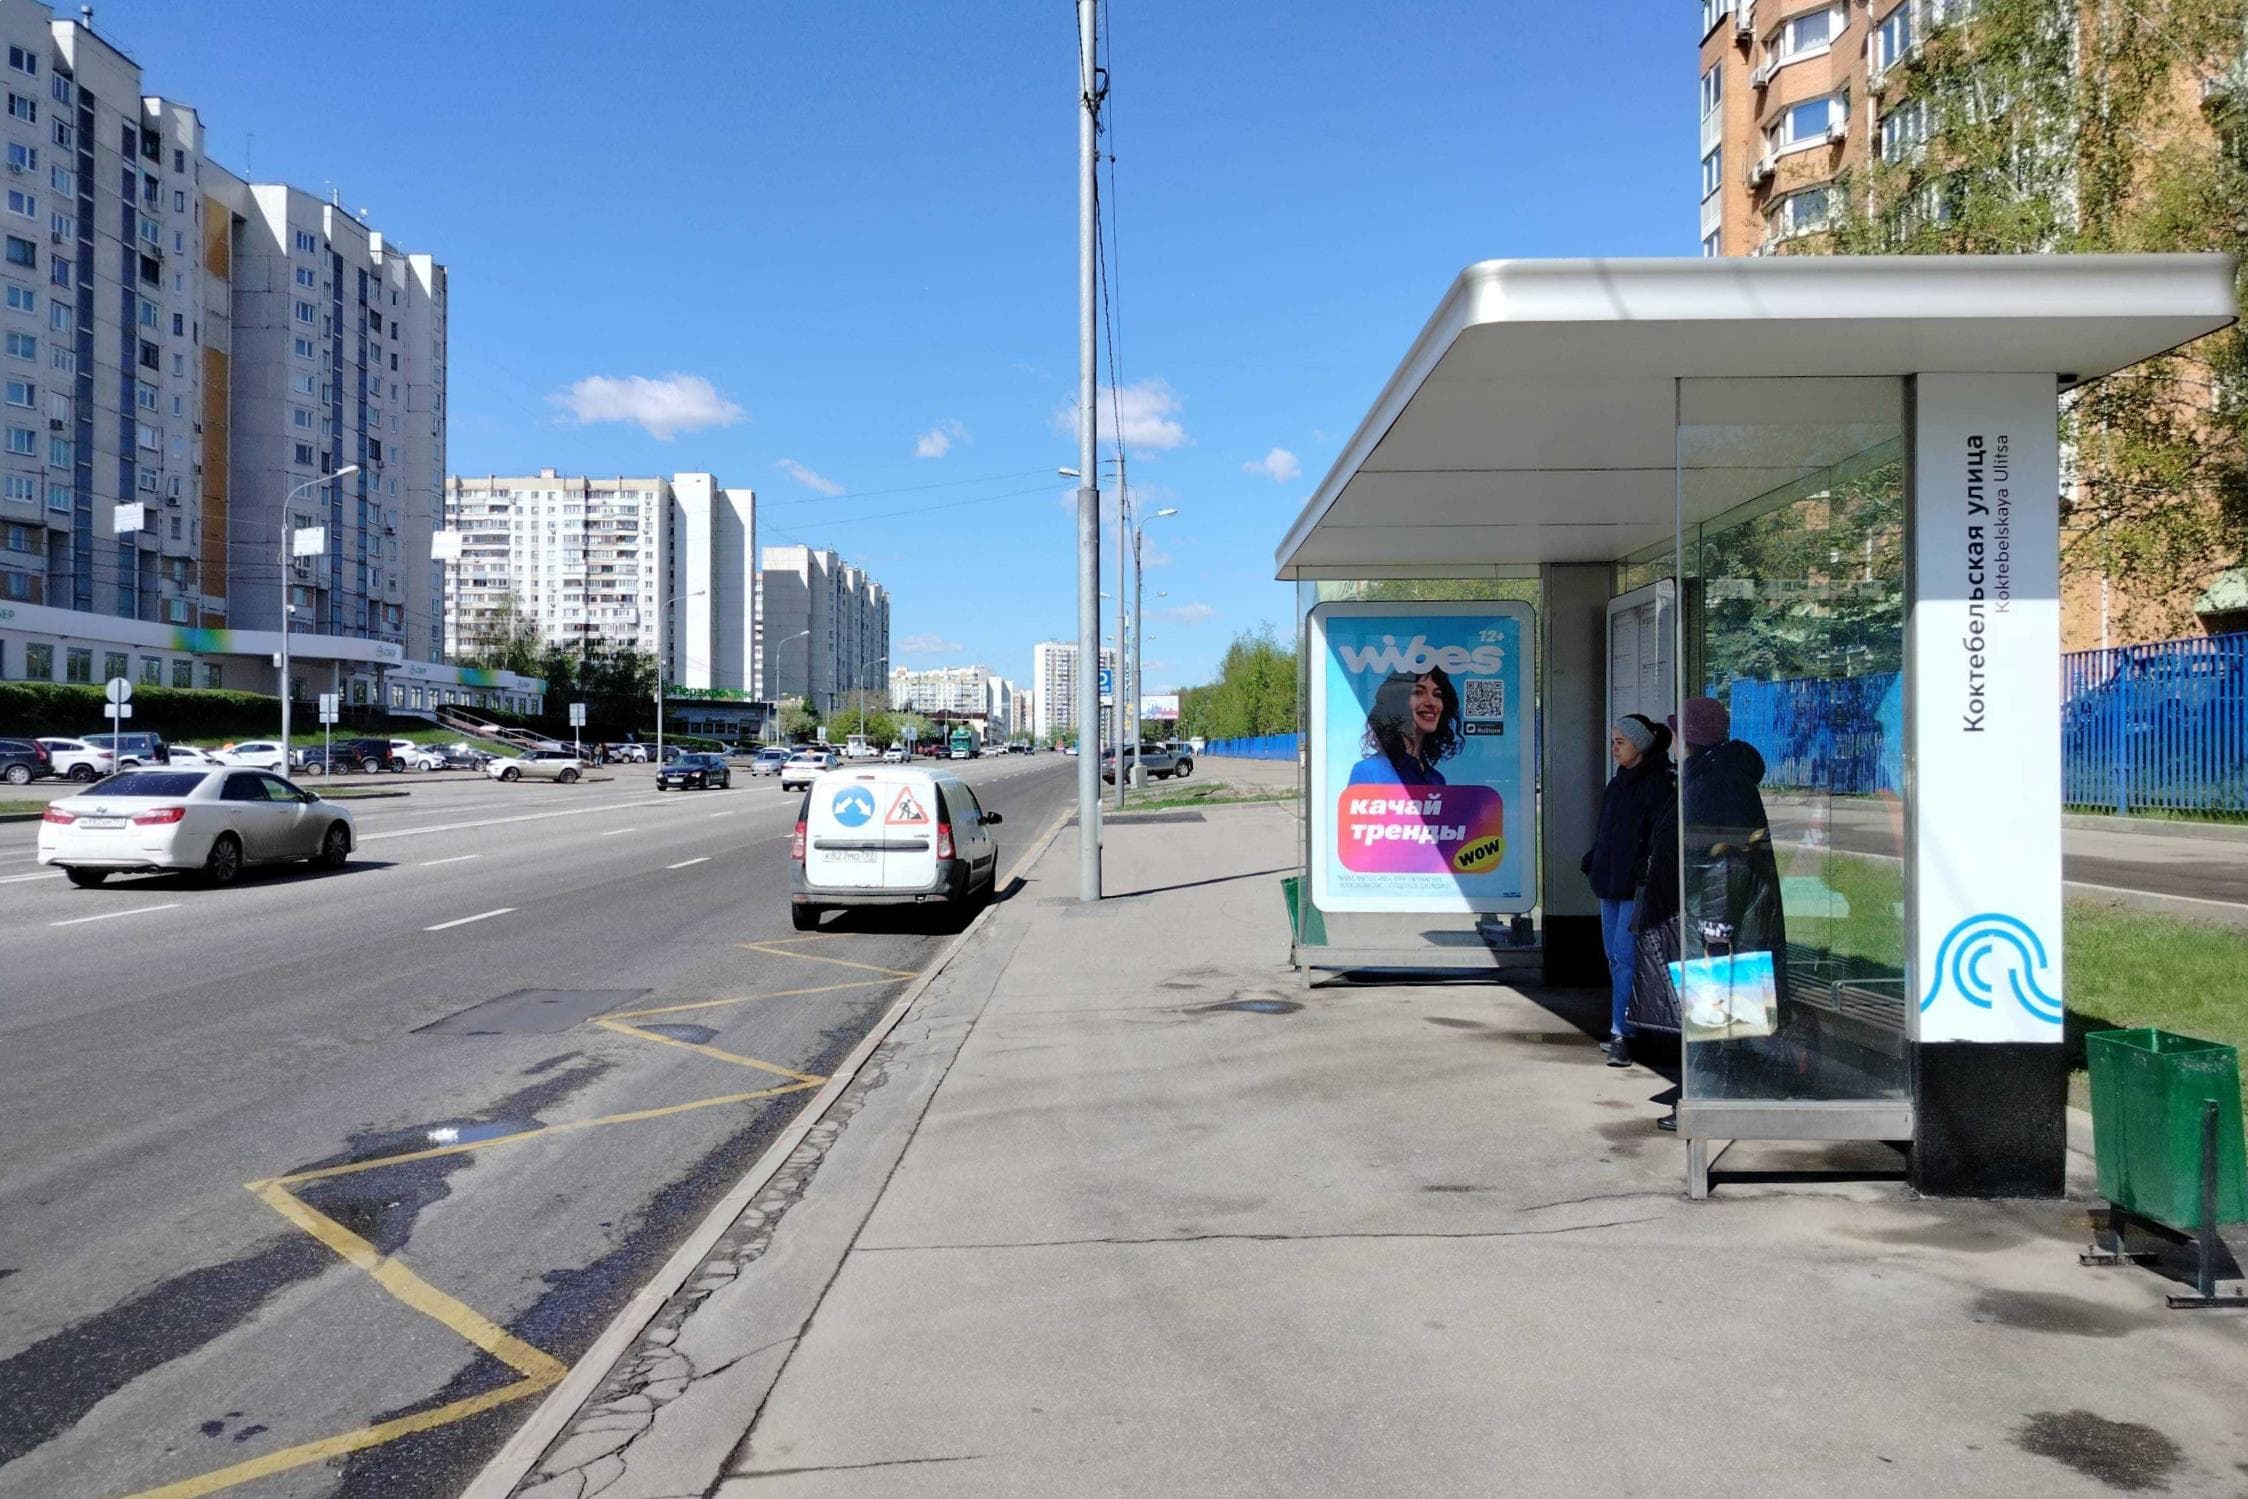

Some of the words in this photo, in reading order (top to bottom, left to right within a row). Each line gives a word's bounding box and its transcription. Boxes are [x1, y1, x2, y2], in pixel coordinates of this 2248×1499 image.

[1967, 434, 1989, 515] улица
[1993, 434, 2009, 483] Ulitsa
[1993, 489, 2012, 614] Koktebelskaya
[1479, 630, 1504, 642] 12+
[1963, 525, 1985, 733] Коктебельская
[1339, 635, 1504, 674] wibes
[1350, 793, 1442, 815] качай
[1350, 824, 1466, 846] тренды
